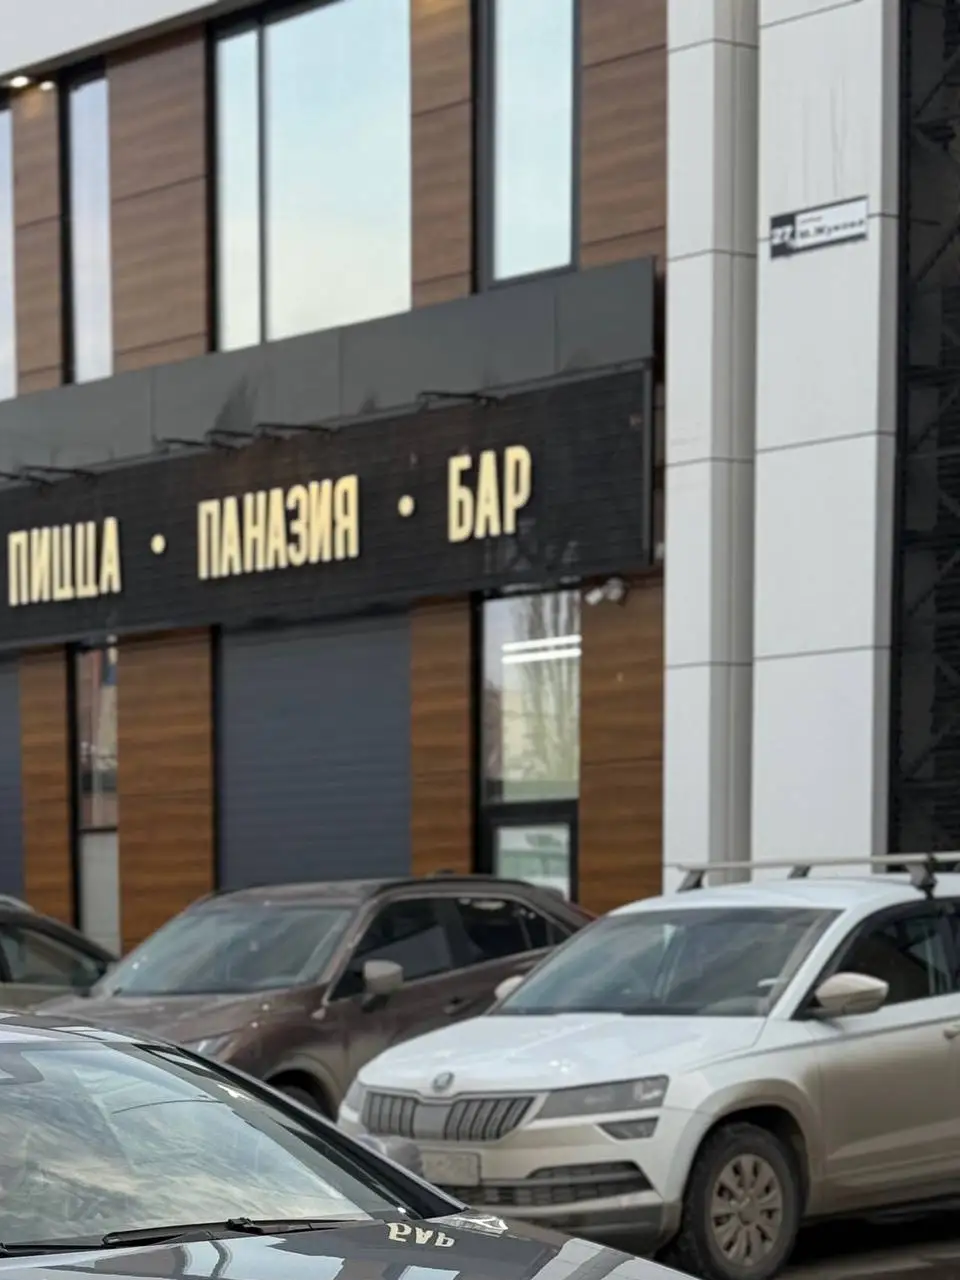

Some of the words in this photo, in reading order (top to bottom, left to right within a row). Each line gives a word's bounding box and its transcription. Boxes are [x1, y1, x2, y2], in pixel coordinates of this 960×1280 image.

[7, 516, 122, 606] ПИЦЦА
[197, 474, 359, 580] ПАНАЗИЯ
[447, 445, 531, 542] БАР
